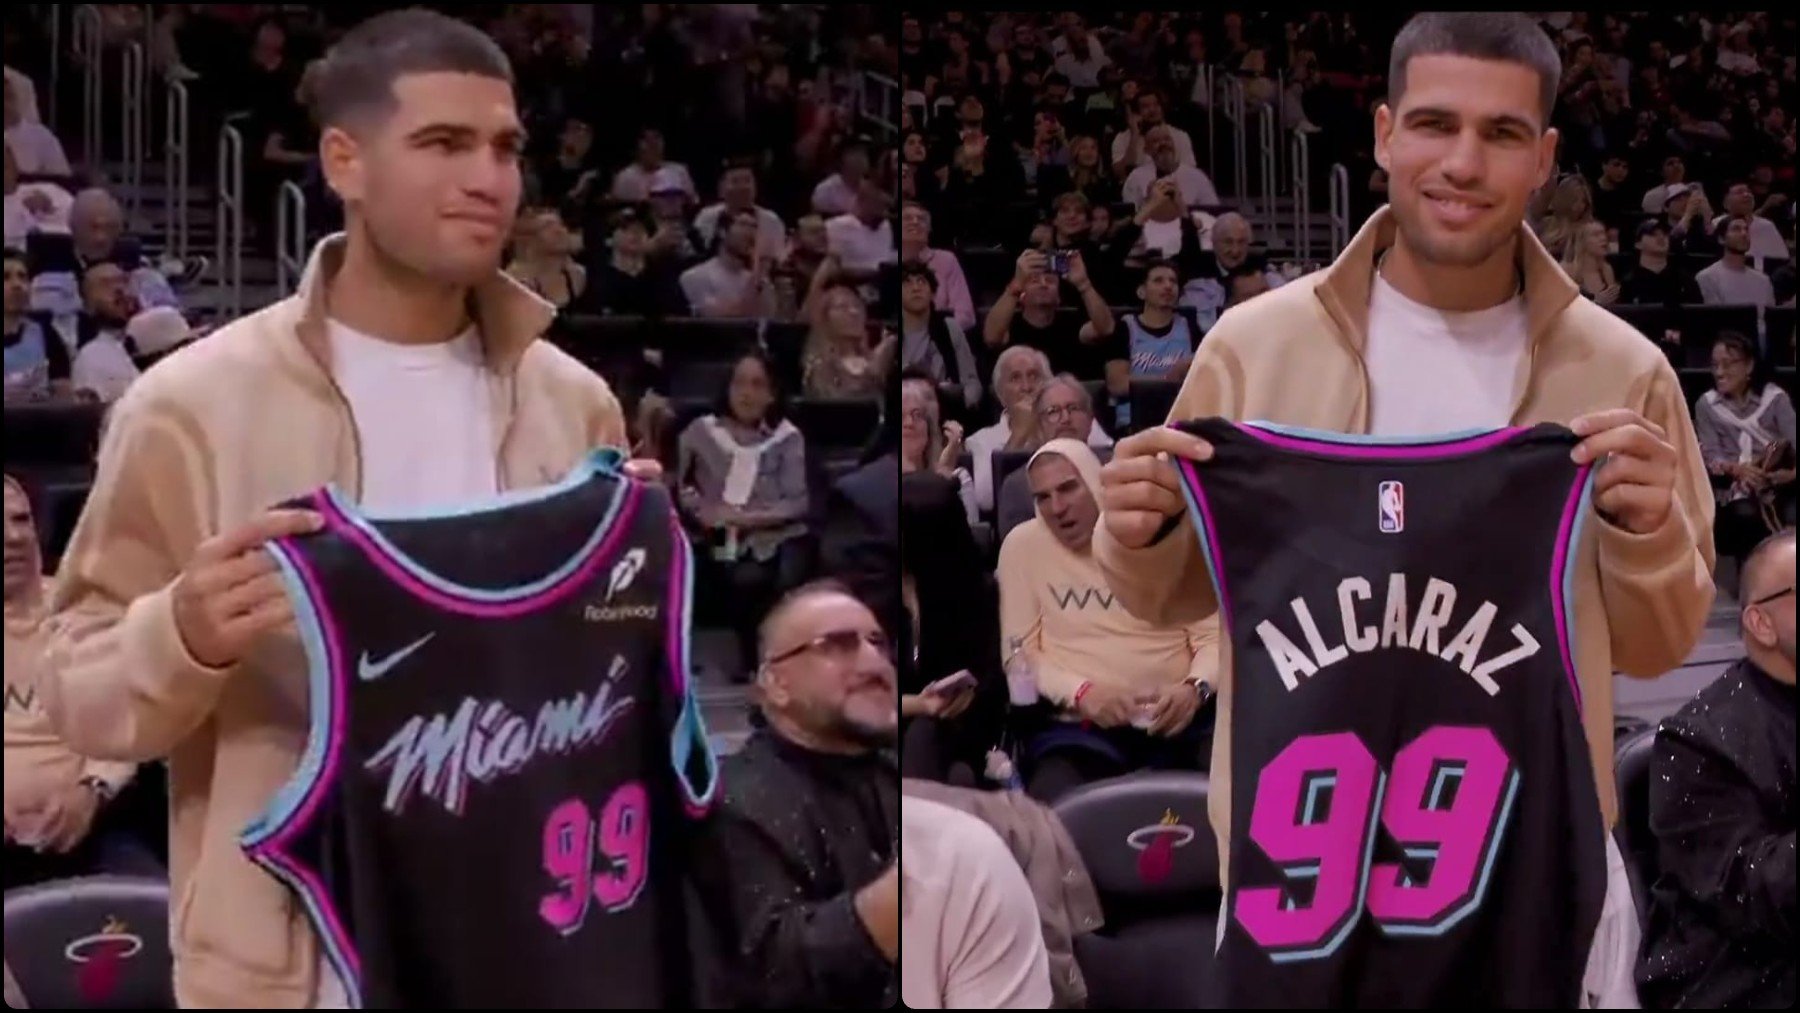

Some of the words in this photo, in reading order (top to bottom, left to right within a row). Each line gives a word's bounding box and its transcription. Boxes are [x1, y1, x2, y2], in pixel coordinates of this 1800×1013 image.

[1255, 572, 1541, 696] ALCARAZ
[362, 654, 636, 818] Miami
[539, 782, 650, 936] 99
[1234, 725, 1521, 964] 99
